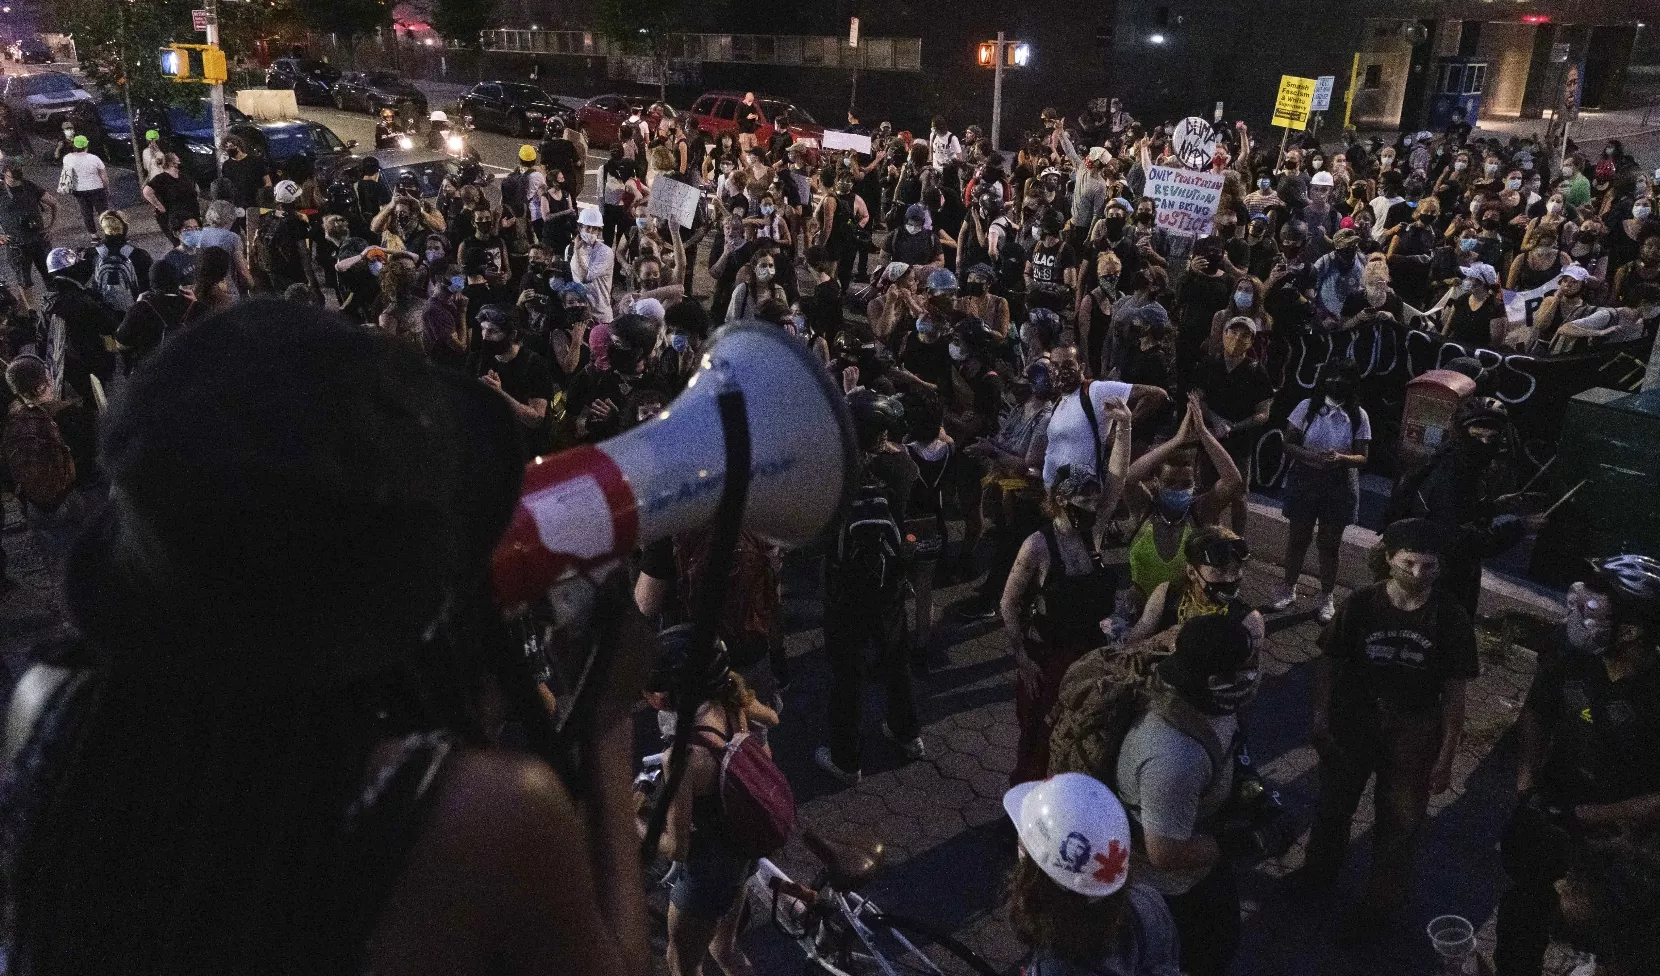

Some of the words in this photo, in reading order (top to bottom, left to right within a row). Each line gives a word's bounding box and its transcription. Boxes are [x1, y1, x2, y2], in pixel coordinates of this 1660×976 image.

[1286, 81, 1309, 91] Smash
[1281, 88, 1310, 98] Fascism
[1287, 96, 1306, 105] White
[1179, 139, 1212, 168] NYPD
[1149, 168, 1173, 181] ONLY
[1154, 198, 1175, 209] CAN
[1179, 202, 1210, 216] BRING
[1157, 211, 1208, 233] USTICE
